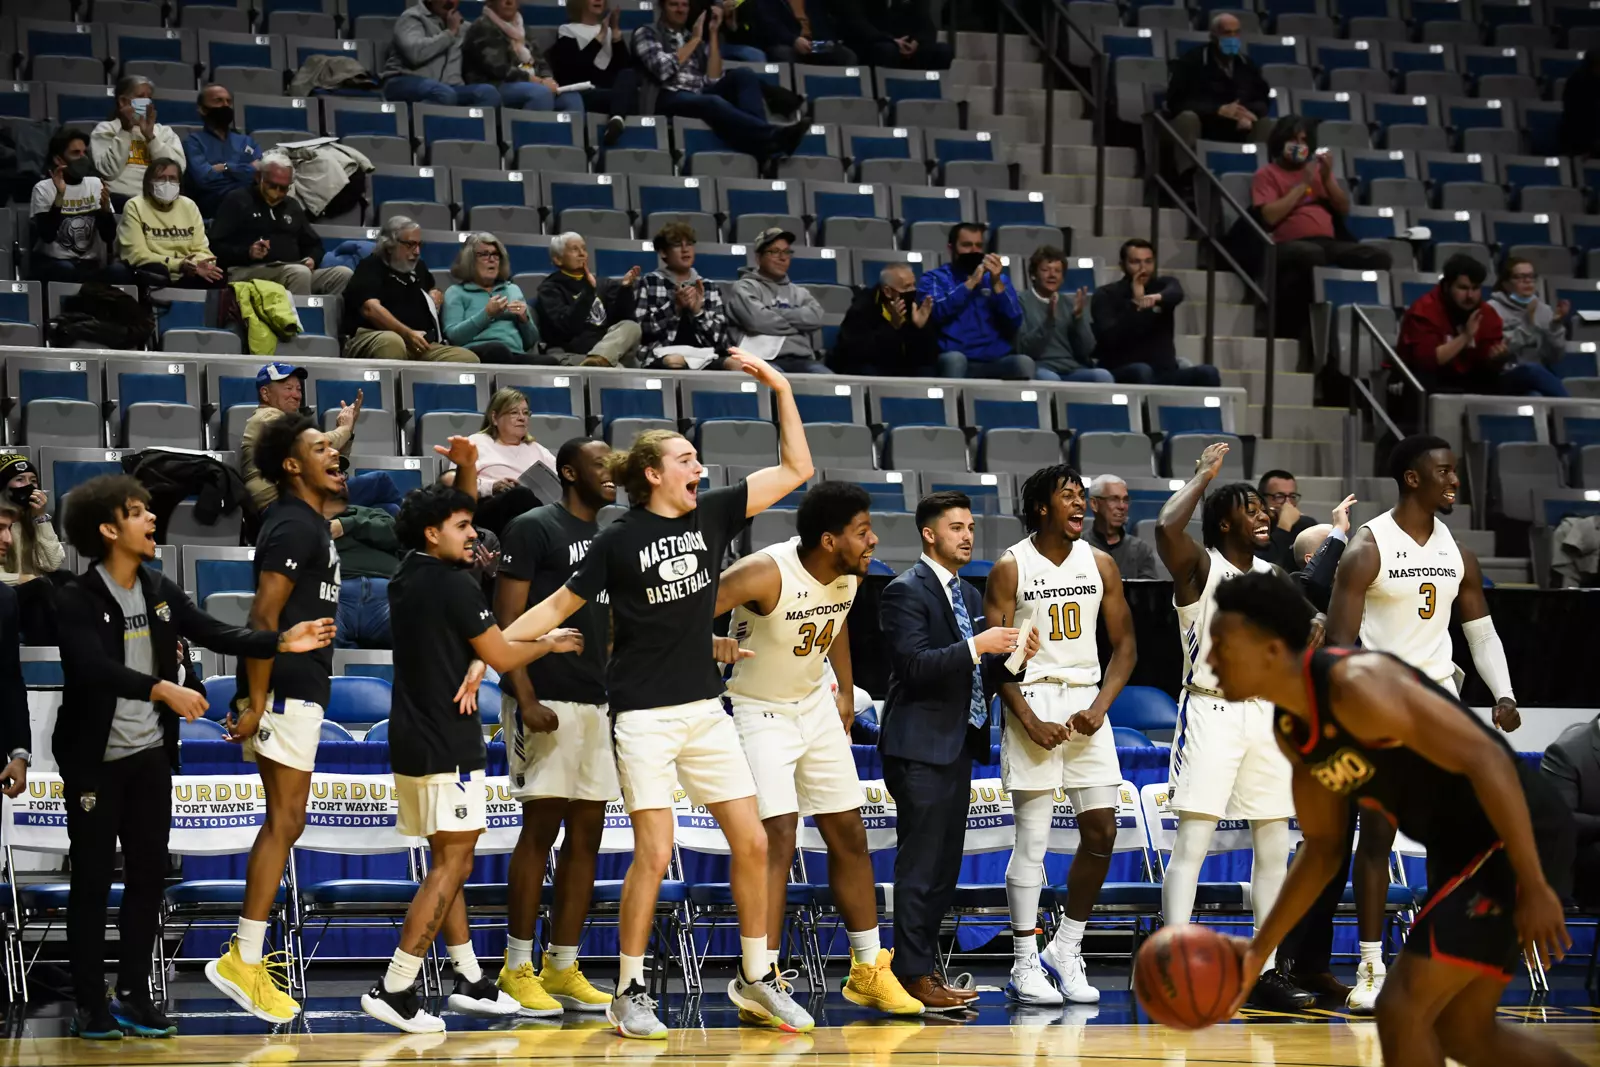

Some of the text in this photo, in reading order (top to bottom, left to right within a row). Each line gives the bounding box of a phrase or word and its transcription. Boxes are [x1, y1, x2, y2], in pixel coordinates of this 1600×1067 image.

[142, 222, 195, 238] Purdue
[638, 530, 708, 572] MASTODON
[1388, 567, 1457, 579] MASTODONS
[646, 568, 712, 604] BASKETBALL
[1024, 585, 1097, 601] MASTODONS
[1418, 582, 1437, 620] 3
[785, 600, 852, 620] MASTODONS
[1048, 601, 1082, 641] 10
[793, 618, 835, 657] 34
[175, 784, 266, 802] URDUE
[311, 782, 399, 800] URDUE
[29, 800, 60, 811] FORT
[175, 802, 254, 813] FORT WAYNE
[311, 801, 388, 811] FORT WAYNE
[486, 803, 516, 813] AYNE
[970, 804, 1000, 815] AYNE
[1053, 805, 1077, 814] FOR
[175, 816, 256, 827] MASTODONS
[310, 815, 389, 825] MASTODONS
